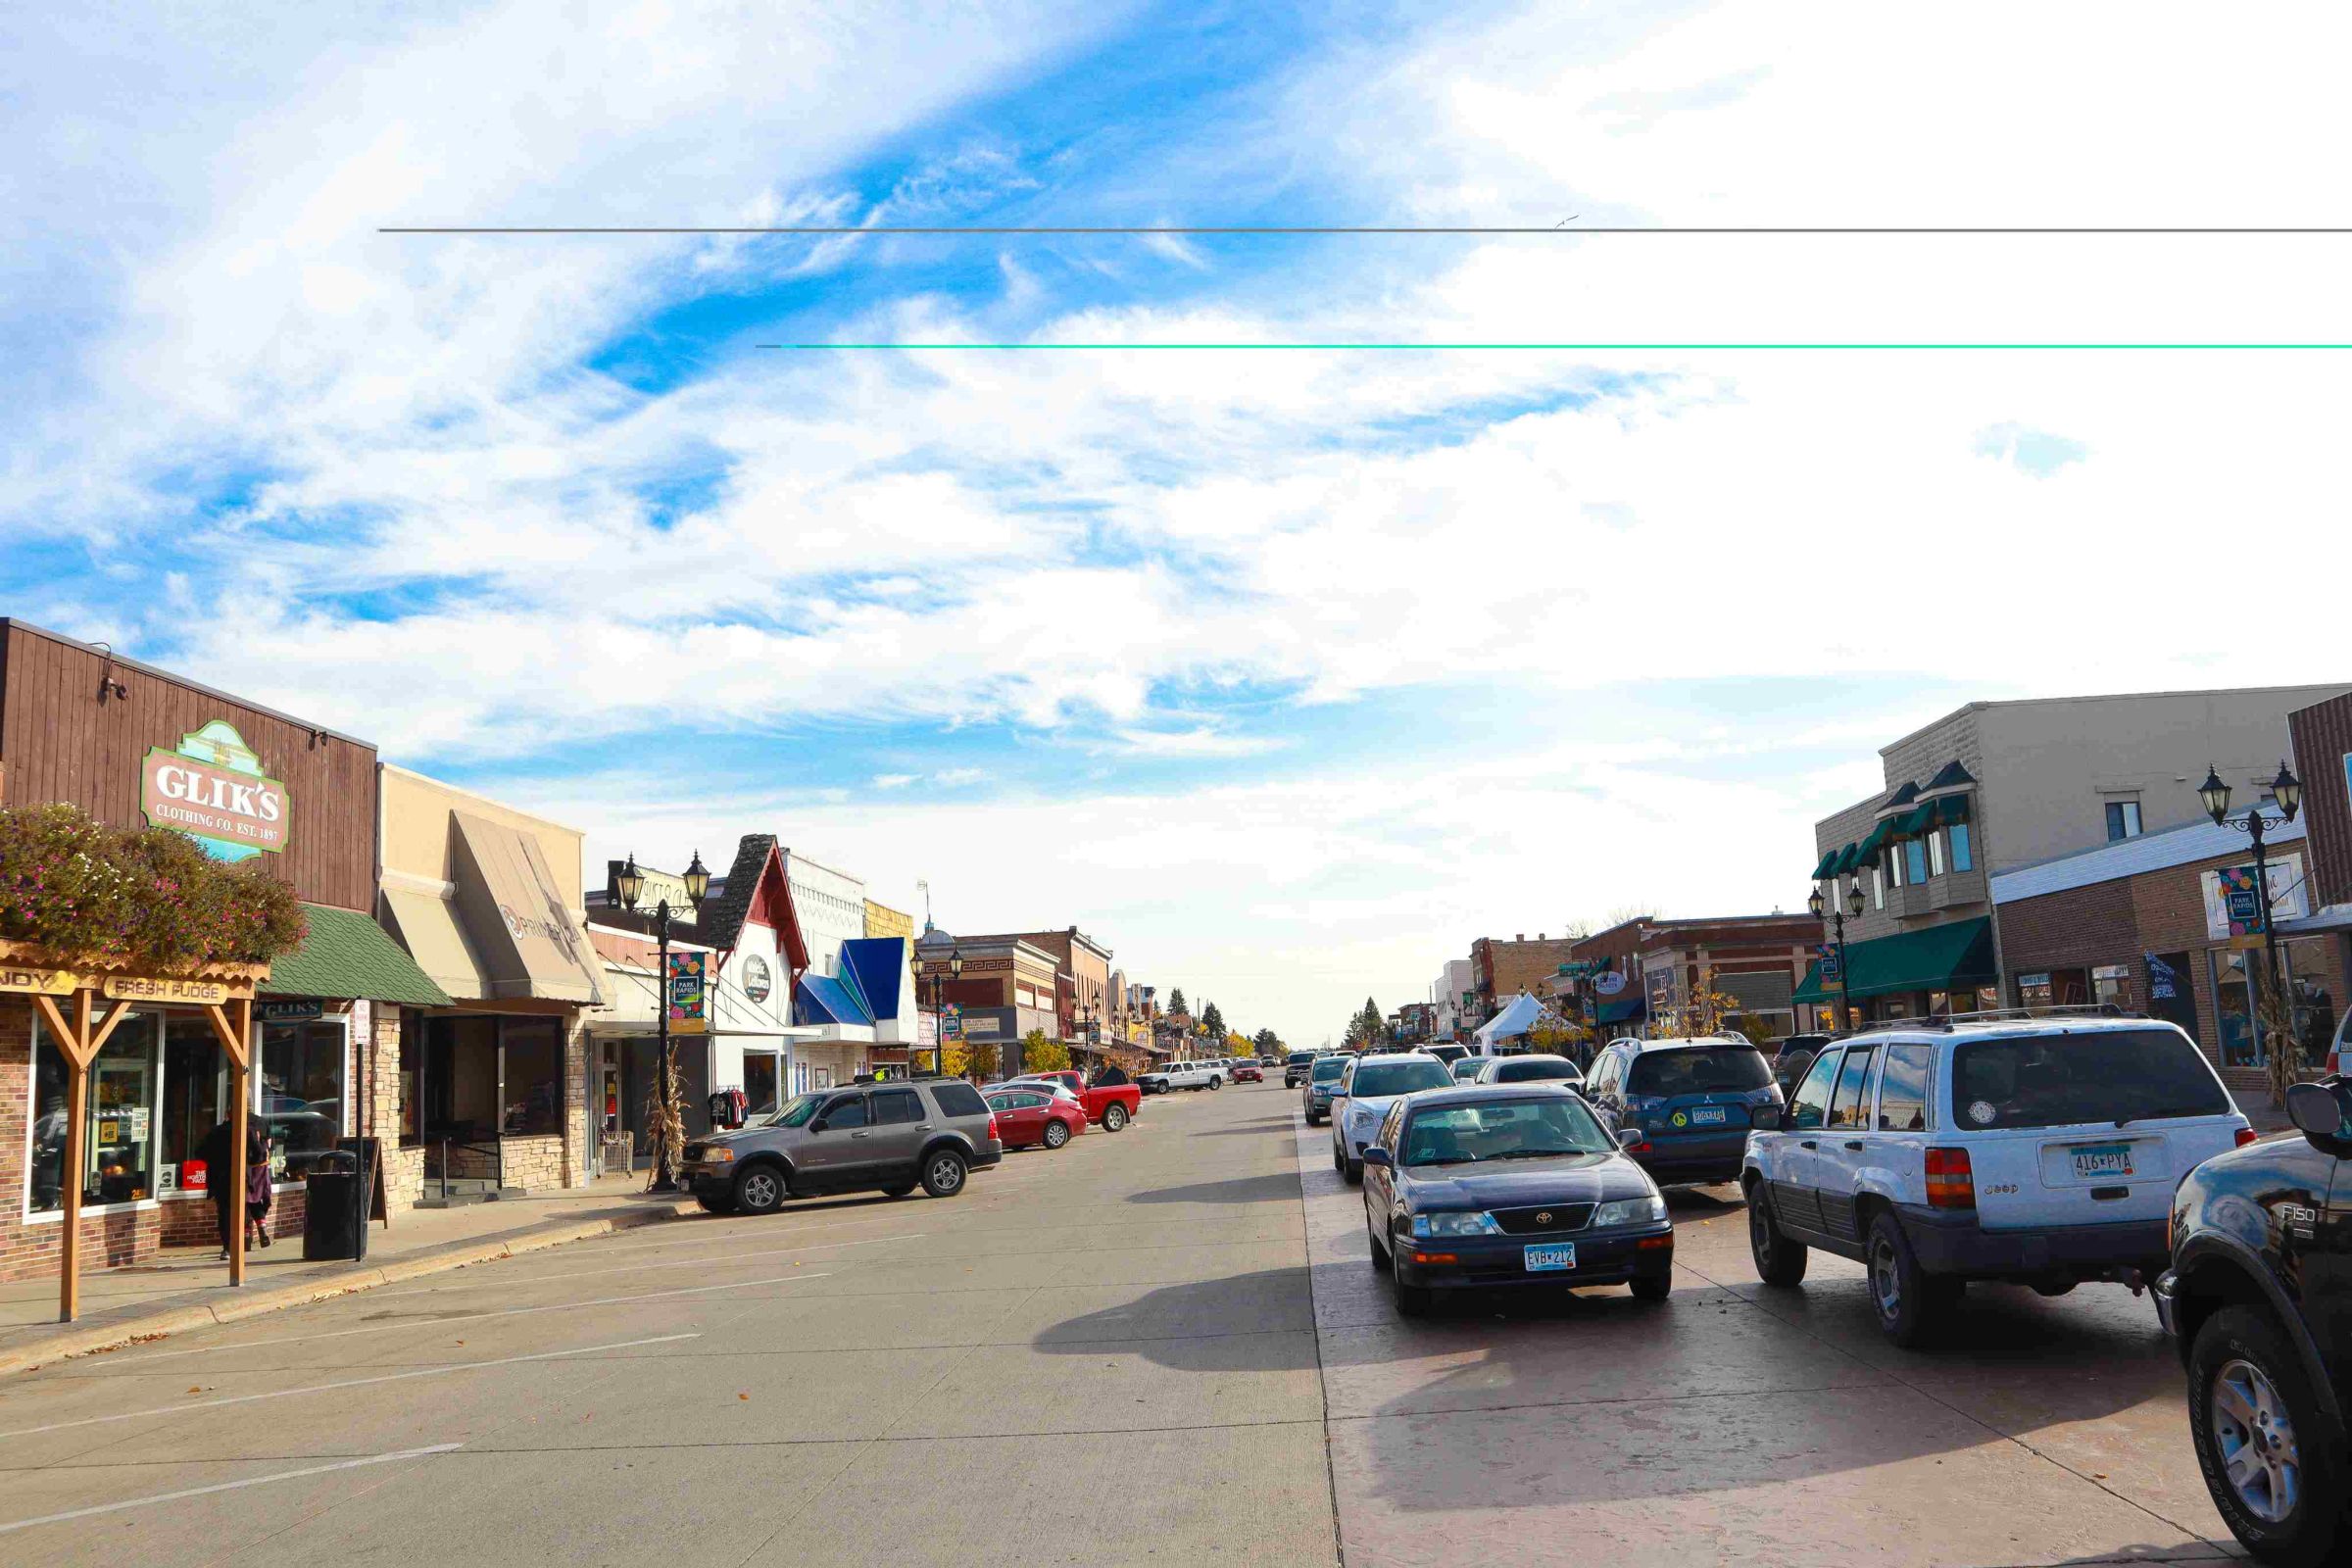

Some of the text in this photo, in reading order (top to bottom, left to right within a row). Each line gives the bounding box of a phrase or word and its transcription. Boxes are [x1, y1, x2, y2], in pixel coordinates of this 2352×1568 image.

[157, 765, 278, 821] GLIK'S
[156, 804, 213, 827] CLOTHING
[217, 817, 233, 831] CO.
[260, 828, 278, 841] 1897
[115, 980, 219, 999] FRESH FUDGE
[266, 1001, 318, 1019] GLIK'S
[2076, 1154, 2132, 1170] 416 PYA
[1984, 1184, 2019, 1194] Jeep
[2282, 1205, 2316, 1221] F150
[1528, 1250, 1572, 1264] EVB 212
